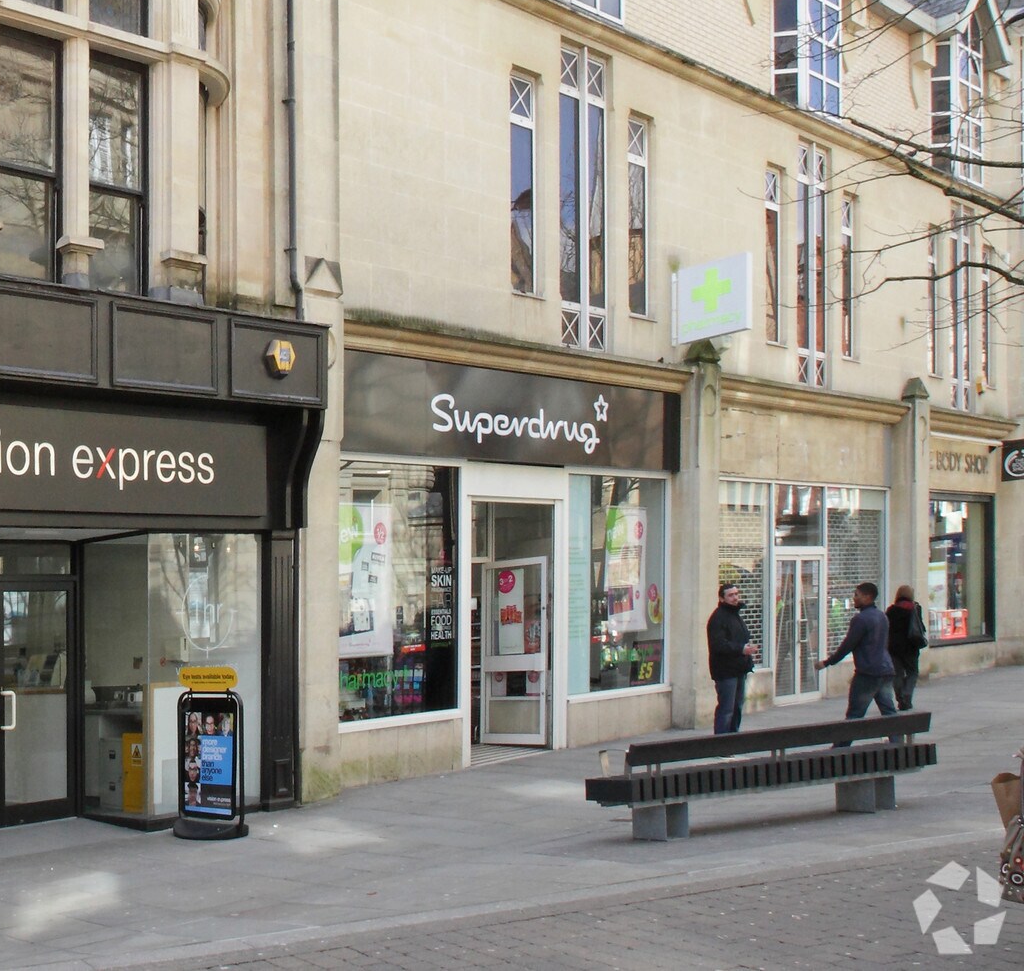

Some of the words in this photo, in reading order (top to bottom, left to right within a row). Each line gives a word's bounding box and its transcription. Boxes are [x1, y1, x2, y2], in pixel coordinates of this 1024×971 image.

[430, 393, 601, 455] Superdrug
[936, 450, 962, 471] BODY
[72, 444, 215, 491] express
[340, 524, 358, 543] ew
[431, 566, 452, 574] MAKE-UP
[431, 574, 452, 587] SKIN
[431, 615, 452, 626] FOOD
[431, 630, 452, 640] HEALTH
[638, 661, 654, 680] £5
[340, 670, 398, 691] harmacy
[202, 738, 217, 746] more
[202, 746, 227, 754] designer
[201, 753, 223, 761] brands
[202, 768, 222, 776] anyone
